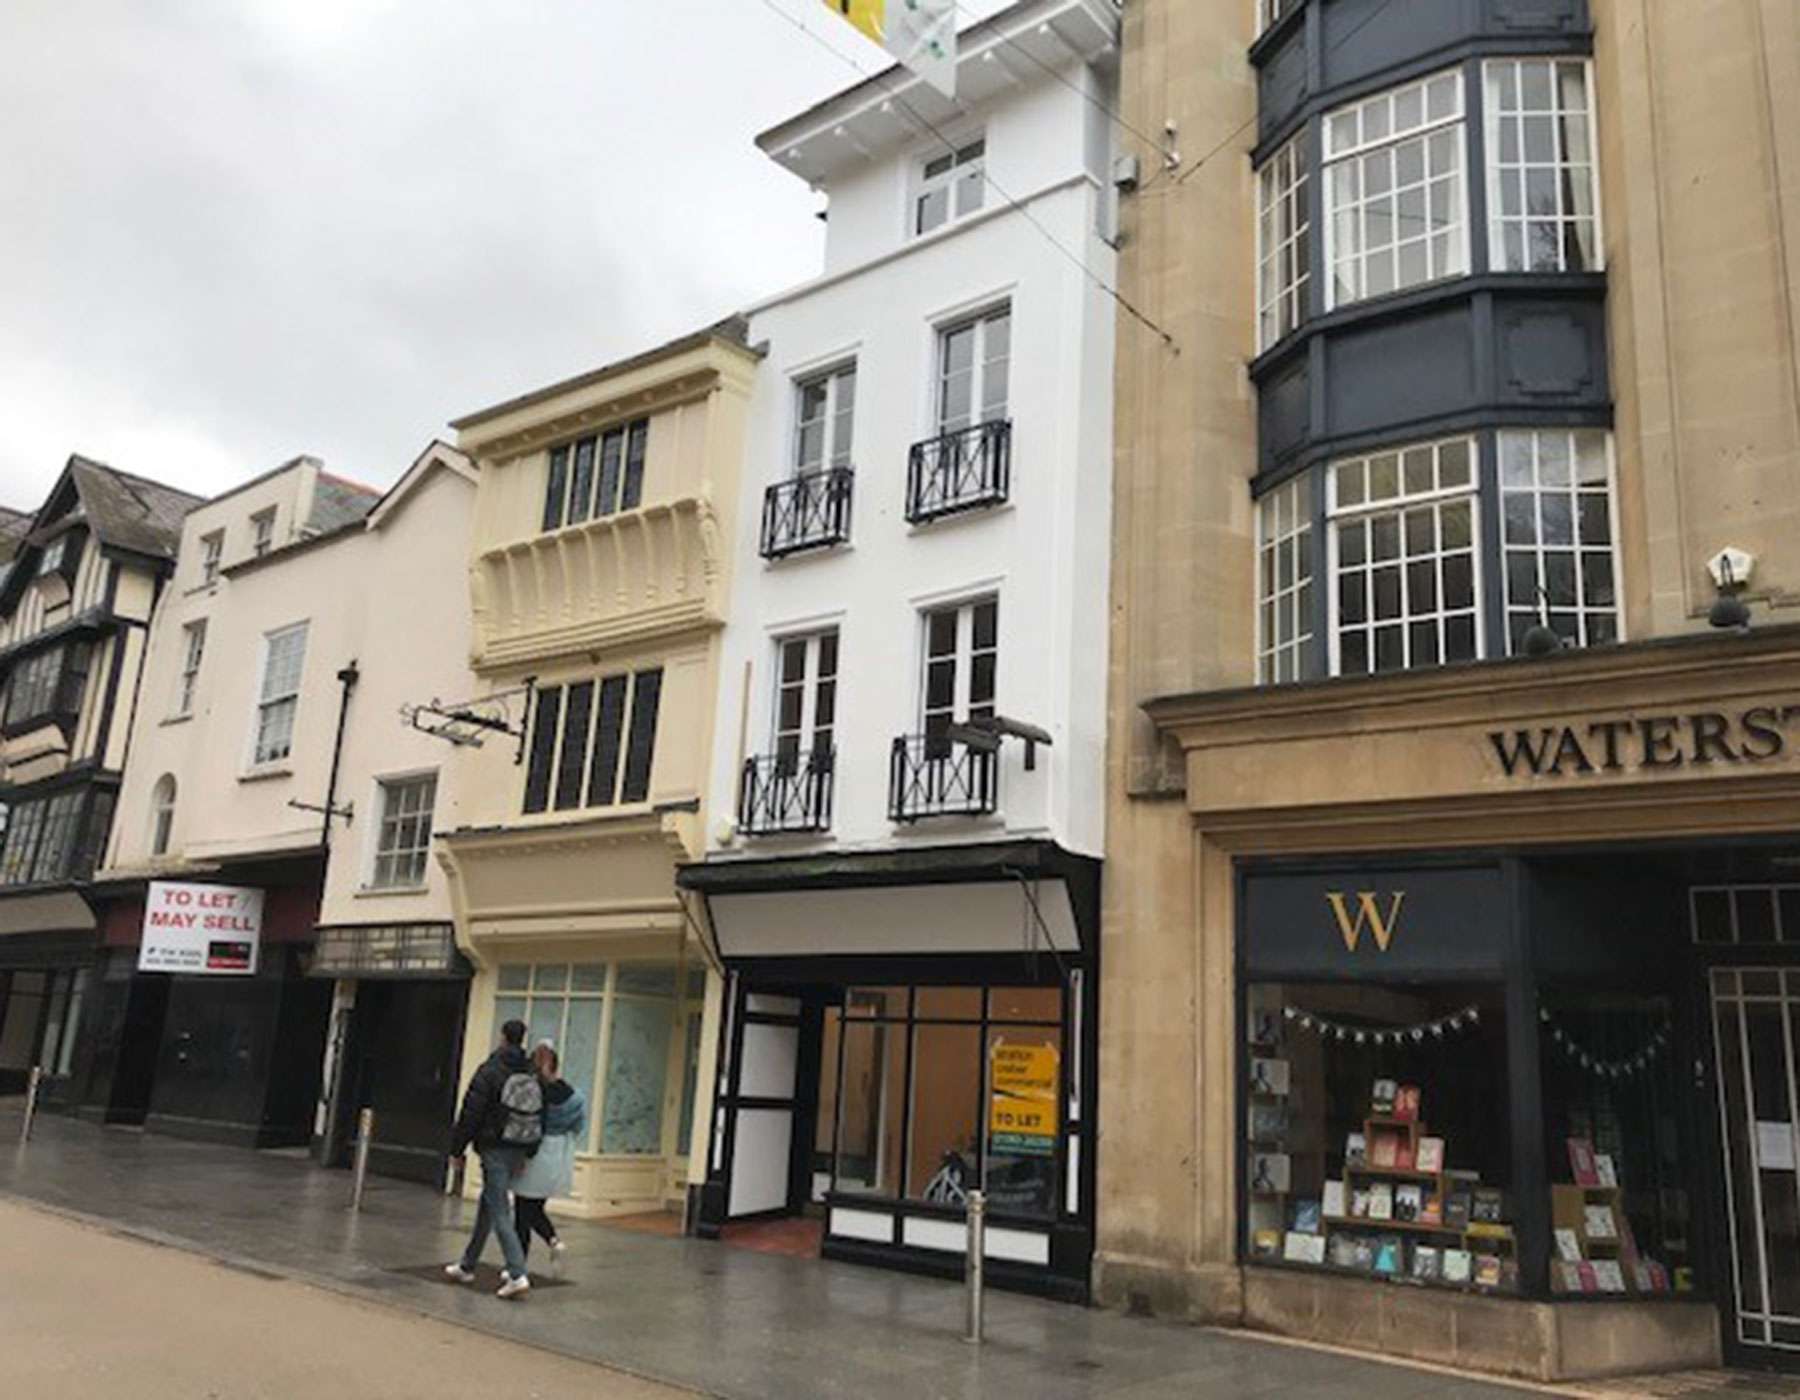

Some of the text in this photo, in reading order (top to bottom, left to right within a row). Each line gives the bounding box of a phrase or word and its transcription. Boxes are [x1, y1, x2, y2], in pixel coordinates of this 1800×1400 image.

[163, 889, 193, 906] TO
[198, 892, 237, 908] LET
[150, 911, 255, 931] MAY SELL
[1325, 891, 1406, 952] W
[996, 1112, 1041, 1127] TO LET
